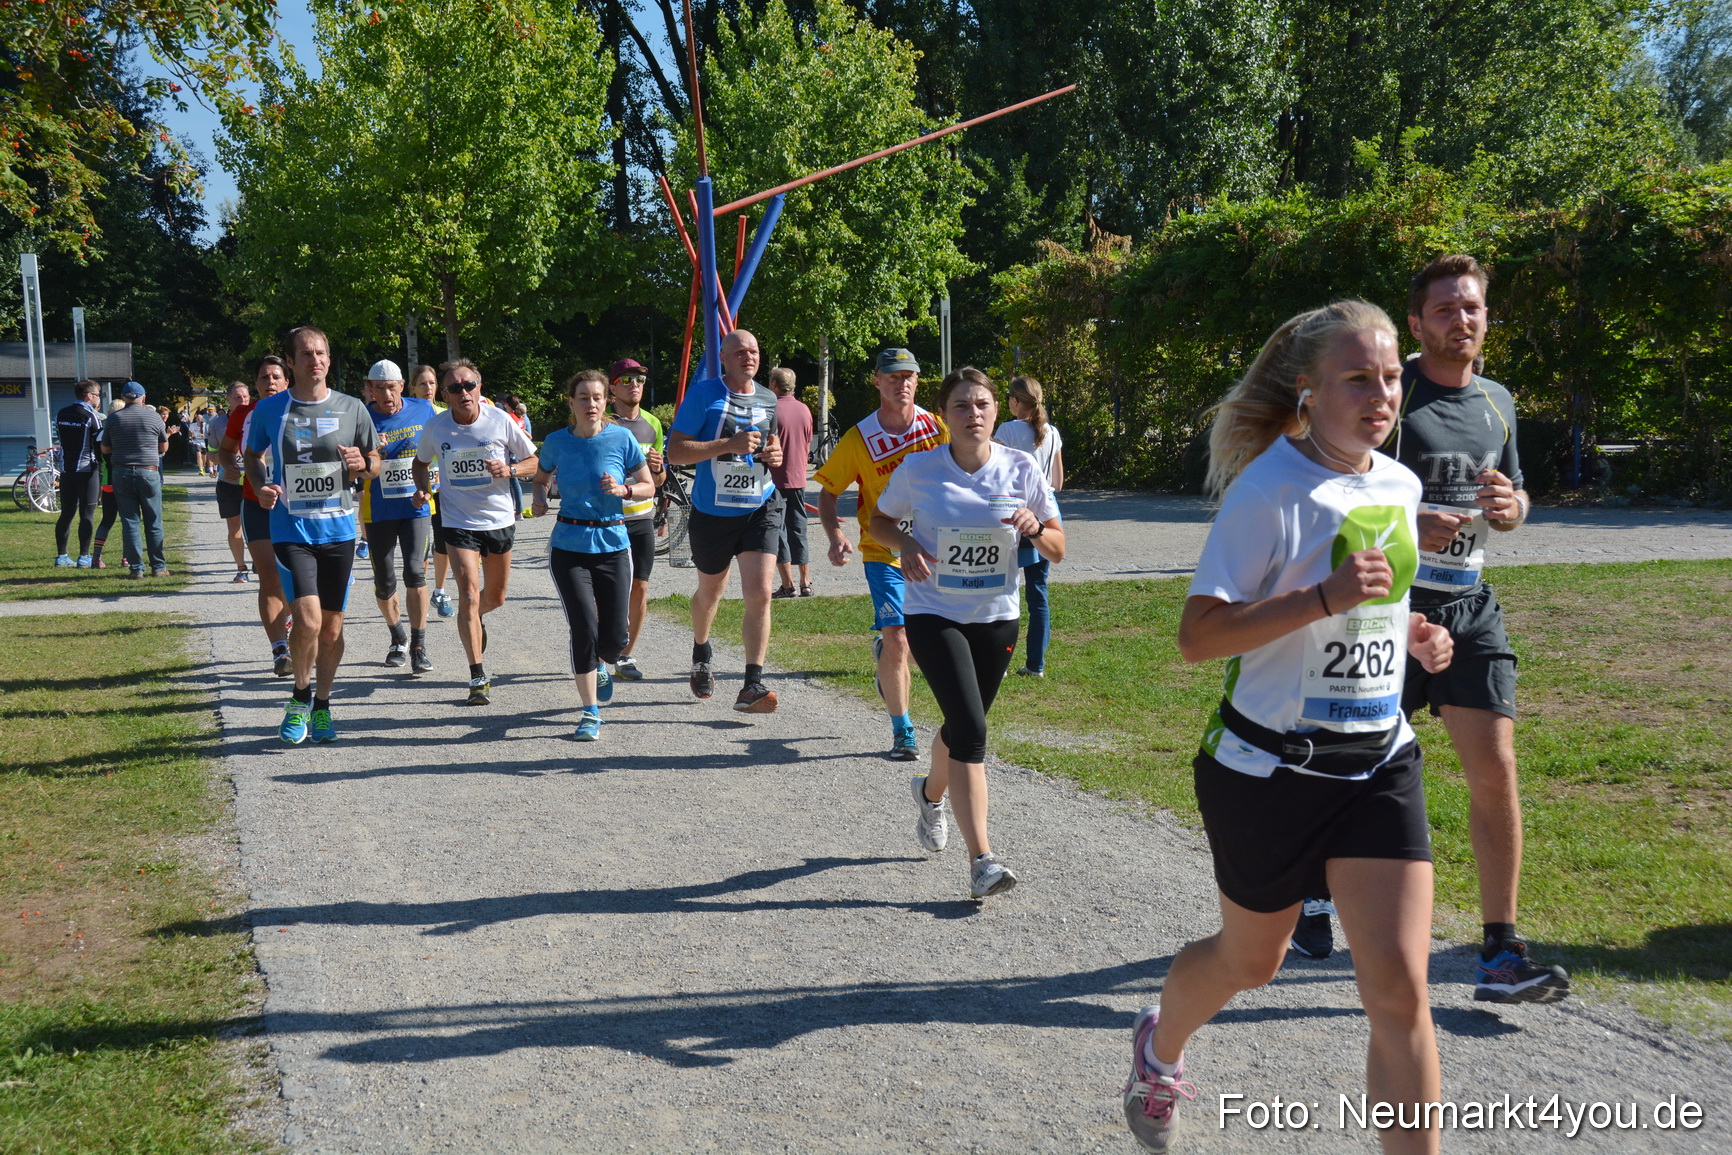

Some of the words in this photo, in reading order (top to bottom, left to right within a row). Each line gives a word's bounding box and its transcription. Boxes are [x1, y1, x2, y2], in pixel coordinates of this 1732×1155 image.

[452, 459, 485, 474] 3053
[385, 469, 413, 482] 2585
[724, 474, 755, 489] 2281
[295, 476, 335, 493] 2009
[1428, 494, 1454, 502] EST.
[960, 533, 992, 541] BOCK
[948, 545, 999, 566] 2428
[1420, 555, 1438, 563] PARTL
[1430, 569, 1454, 582] Felix
[962, 579, 984, 589] Katja
[1347, 617, 1387, 631] BOCK
[1322, 639, 1395, 679] 2262
[1329, 685, 1356, 693] PARTL
[1358, 685, 1385, 693] Neumarkt
[1329, 701, 1389, 719] Franziska
